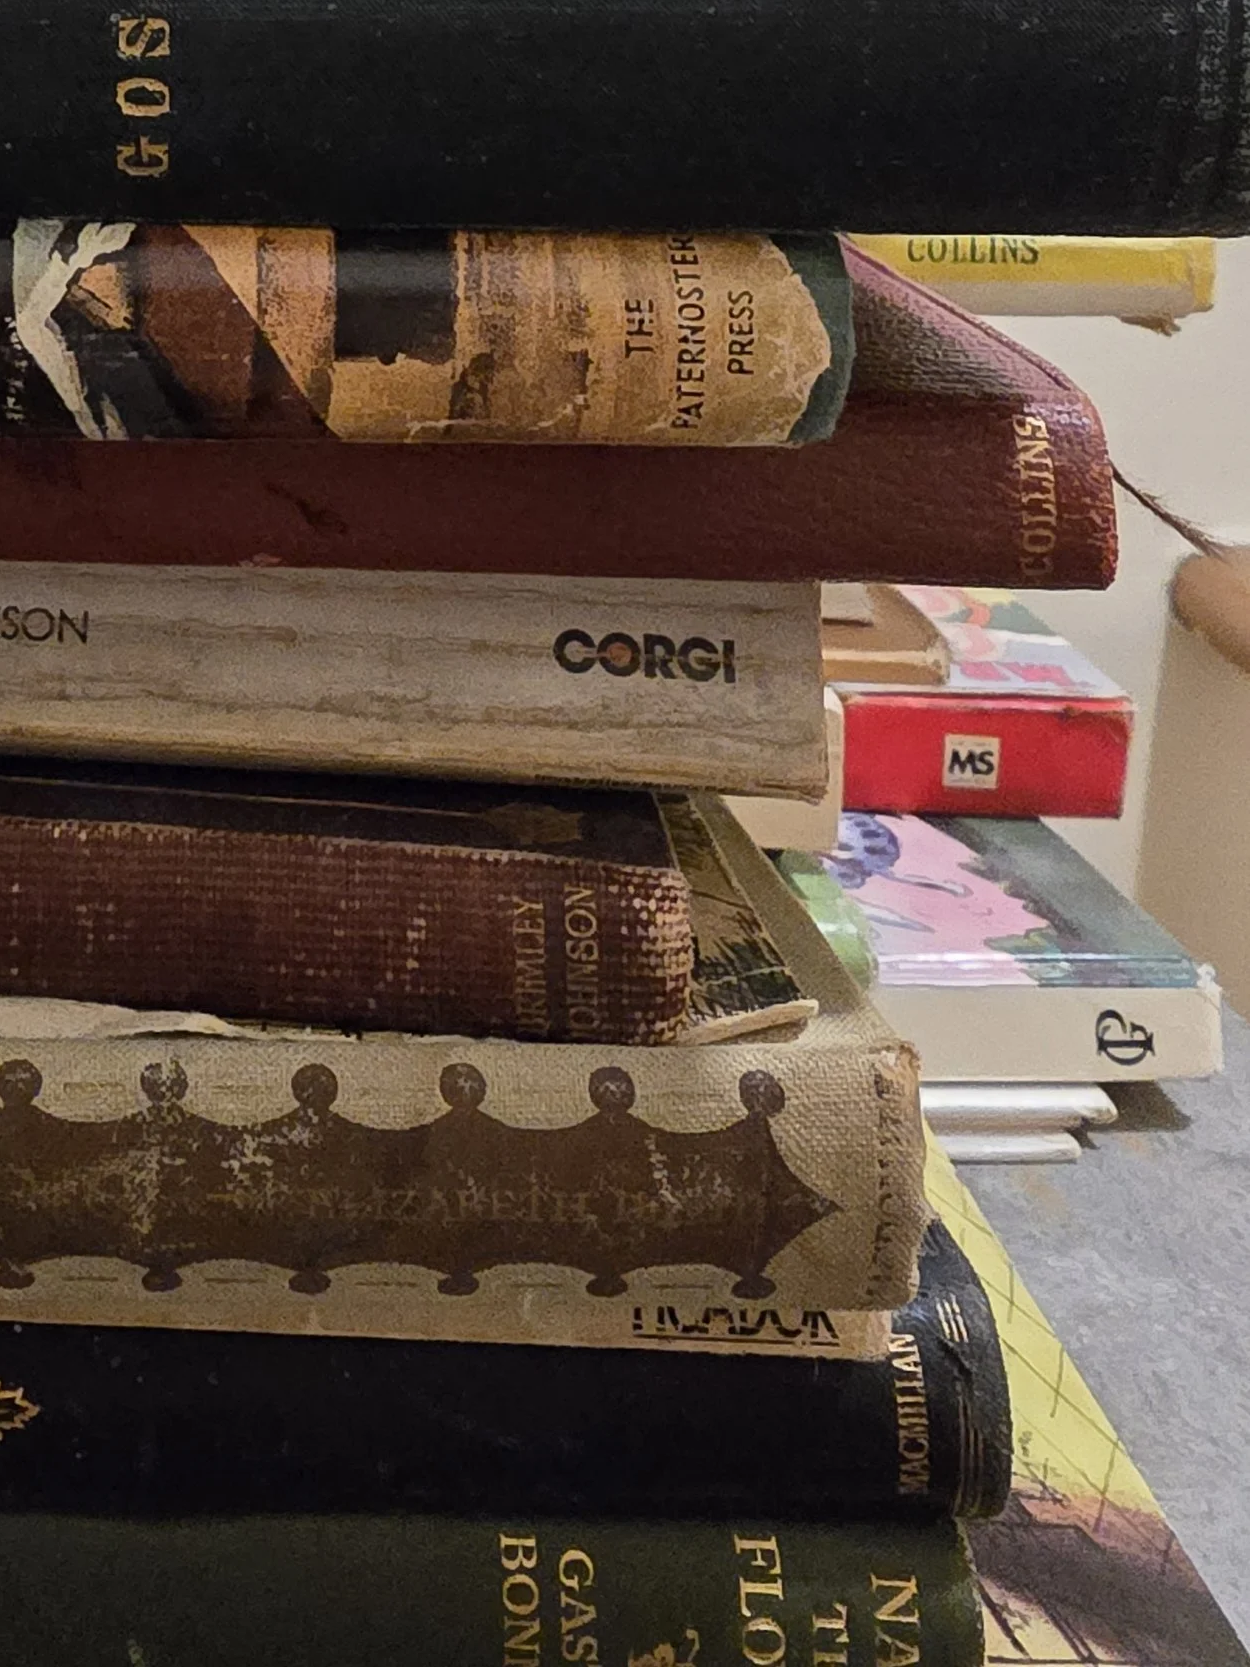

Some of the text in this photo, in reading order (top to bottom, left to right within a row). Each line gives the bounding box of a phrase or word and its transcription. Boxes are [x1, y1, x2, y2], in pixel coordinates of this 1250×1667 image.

[907, 235, 1040, 266] COLLINS
[623, 297, 655, 359] THE
[669, 234, 707, 430] PATERNOSTER
[726, 288, 755, 376] PRESS
[1011, 413, 1058, 576] COLLINS
[552, 627, 738, 685] CORGI
[948, 748, 995, 777] MS
[886, 1332, 931, 1495] MACMILLAN
